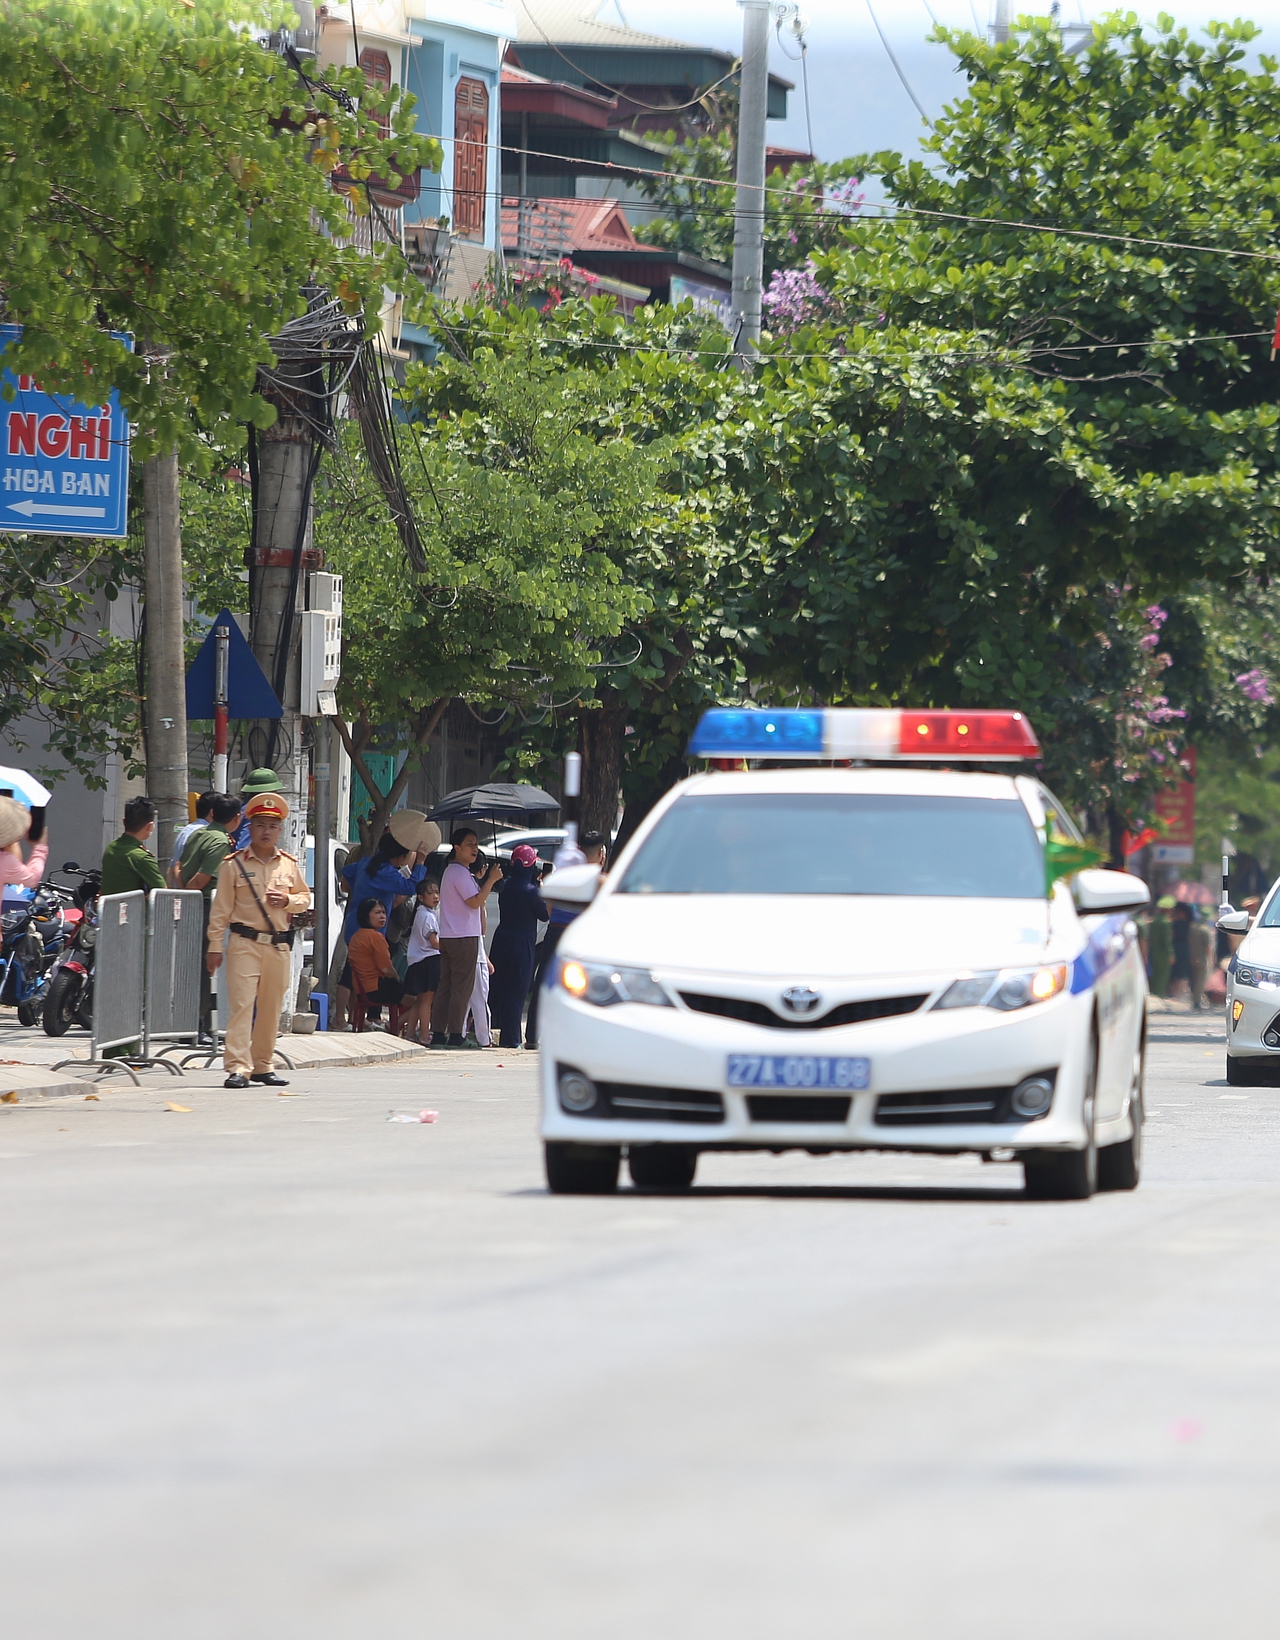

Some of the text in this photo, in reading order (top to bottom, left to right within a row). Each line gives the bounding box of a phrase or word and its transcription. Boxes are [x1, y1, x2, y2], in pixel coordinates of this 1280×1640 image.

[7, 402, 113, 462] NGHỈ
[3, 467, 111, 497] HOA BAN
